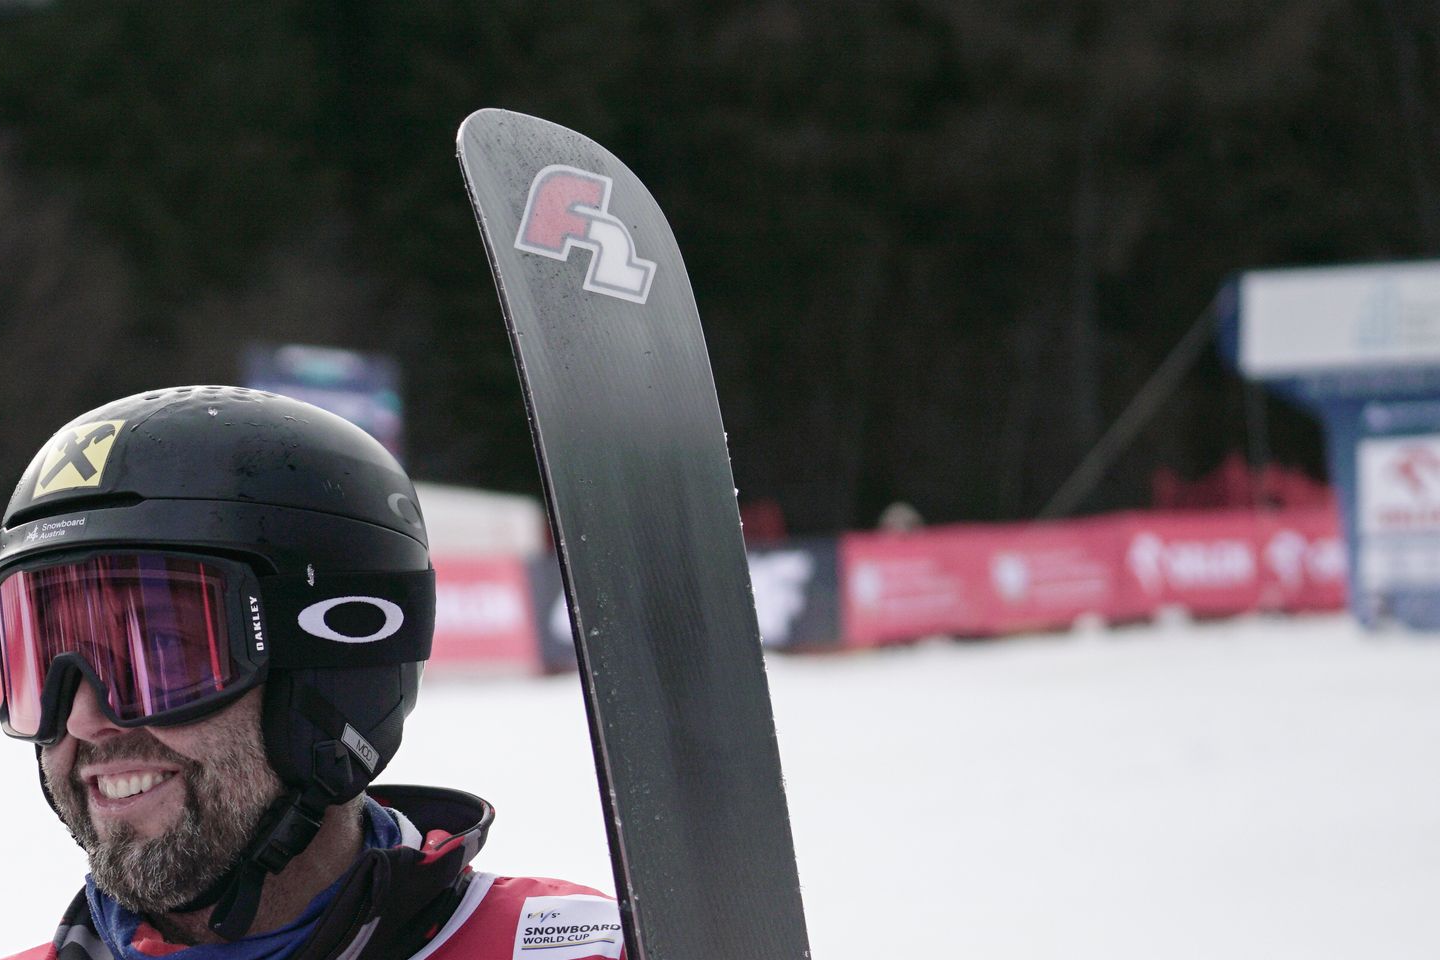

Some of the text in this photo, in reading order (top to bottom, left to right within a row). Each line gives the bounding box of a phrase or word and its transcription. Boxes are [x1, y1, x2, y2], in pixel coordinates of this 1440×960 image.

[41, 517, 86, 531] Snowboard
[39, 529, 66, 540] Austria
[249, 595, 264, 651] OAKLEY
[524, 924, 621, 936] SNOWBOARD
[523, 935, 564, 945] WORLD
